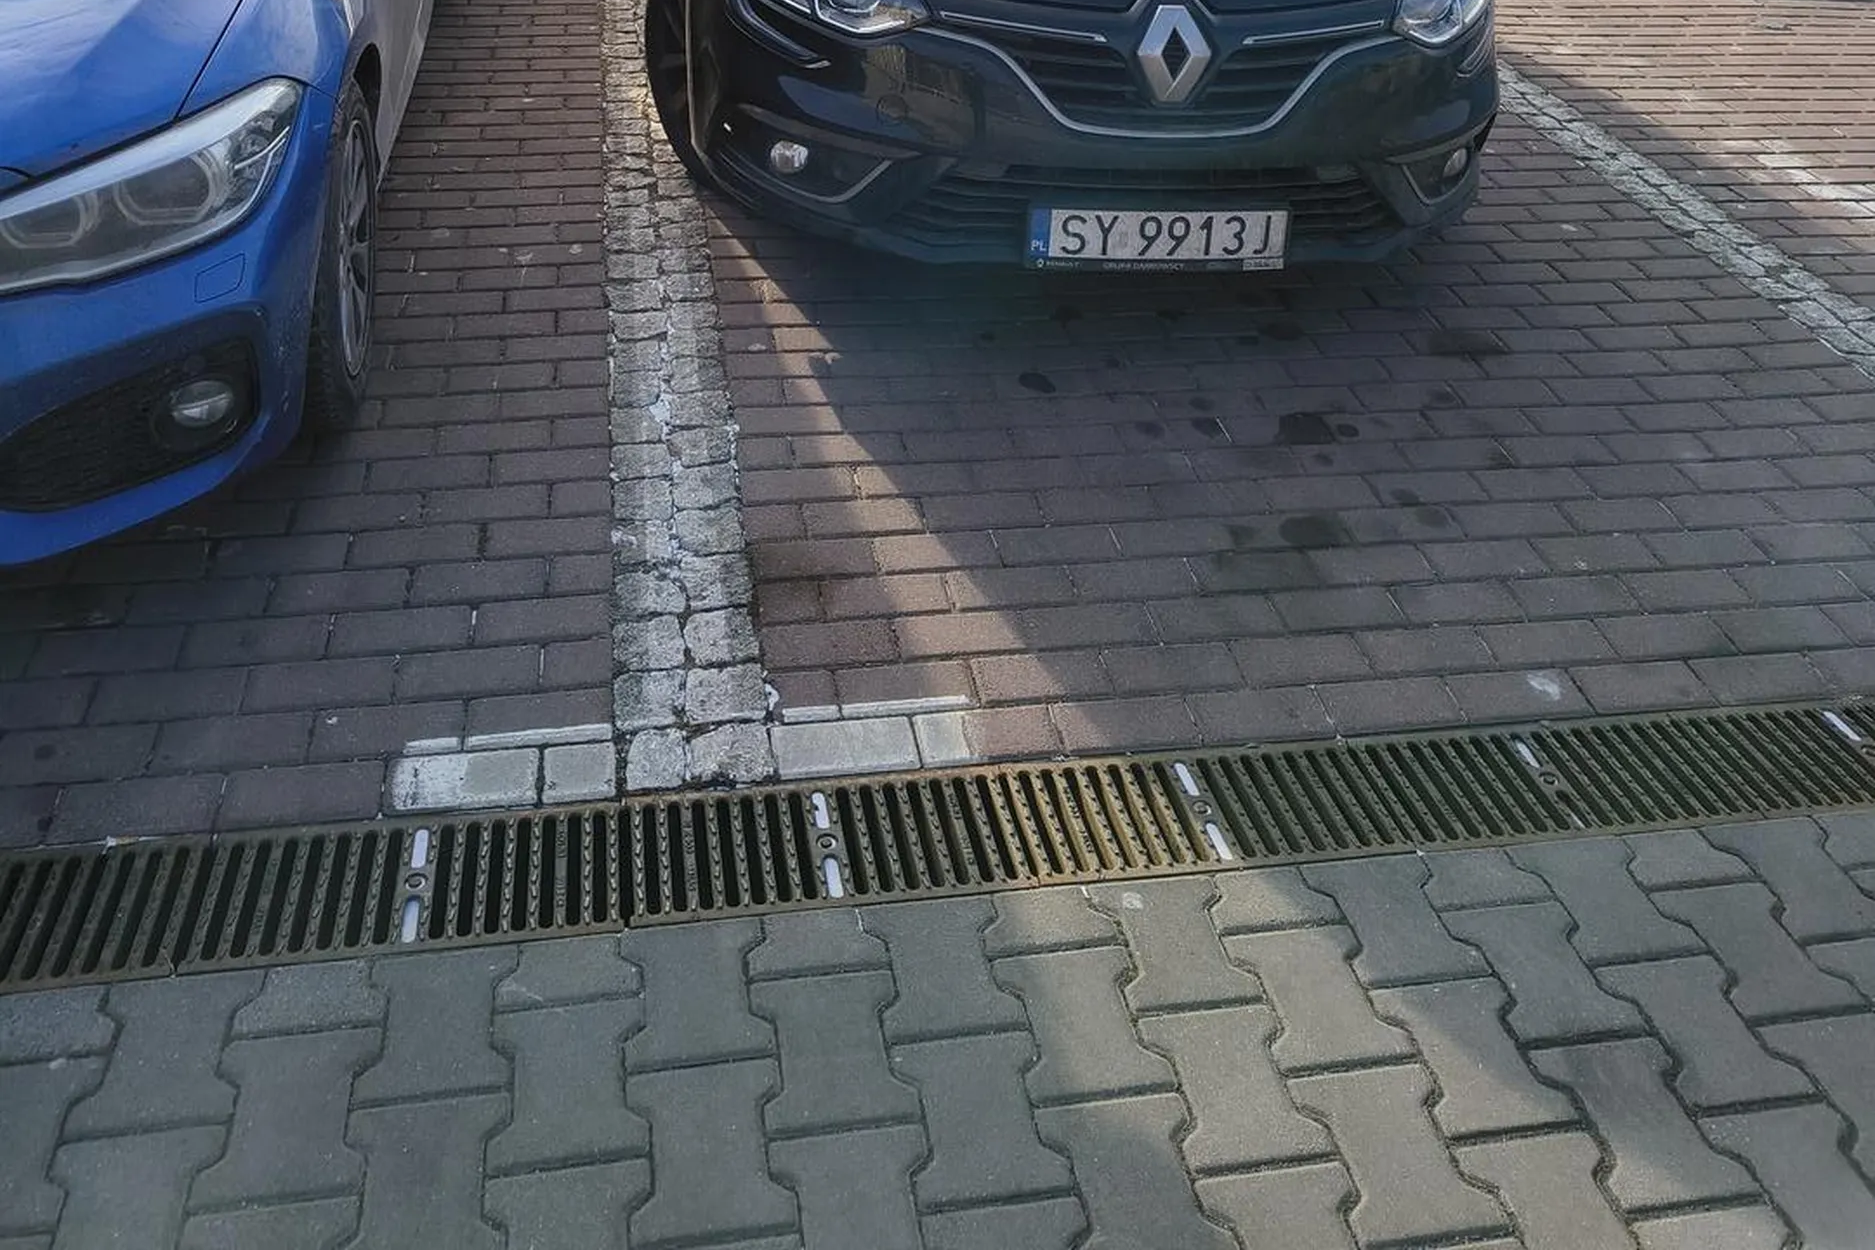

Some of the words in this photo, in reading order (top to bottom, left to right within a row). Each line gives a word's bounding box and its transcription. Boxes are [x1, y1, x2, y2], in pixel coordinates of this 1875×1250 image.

[1031, 240, 1046, 252] PL
[1060, 214, 1120, 256] SY
[1138, 215, 1273, 256] 9913J
